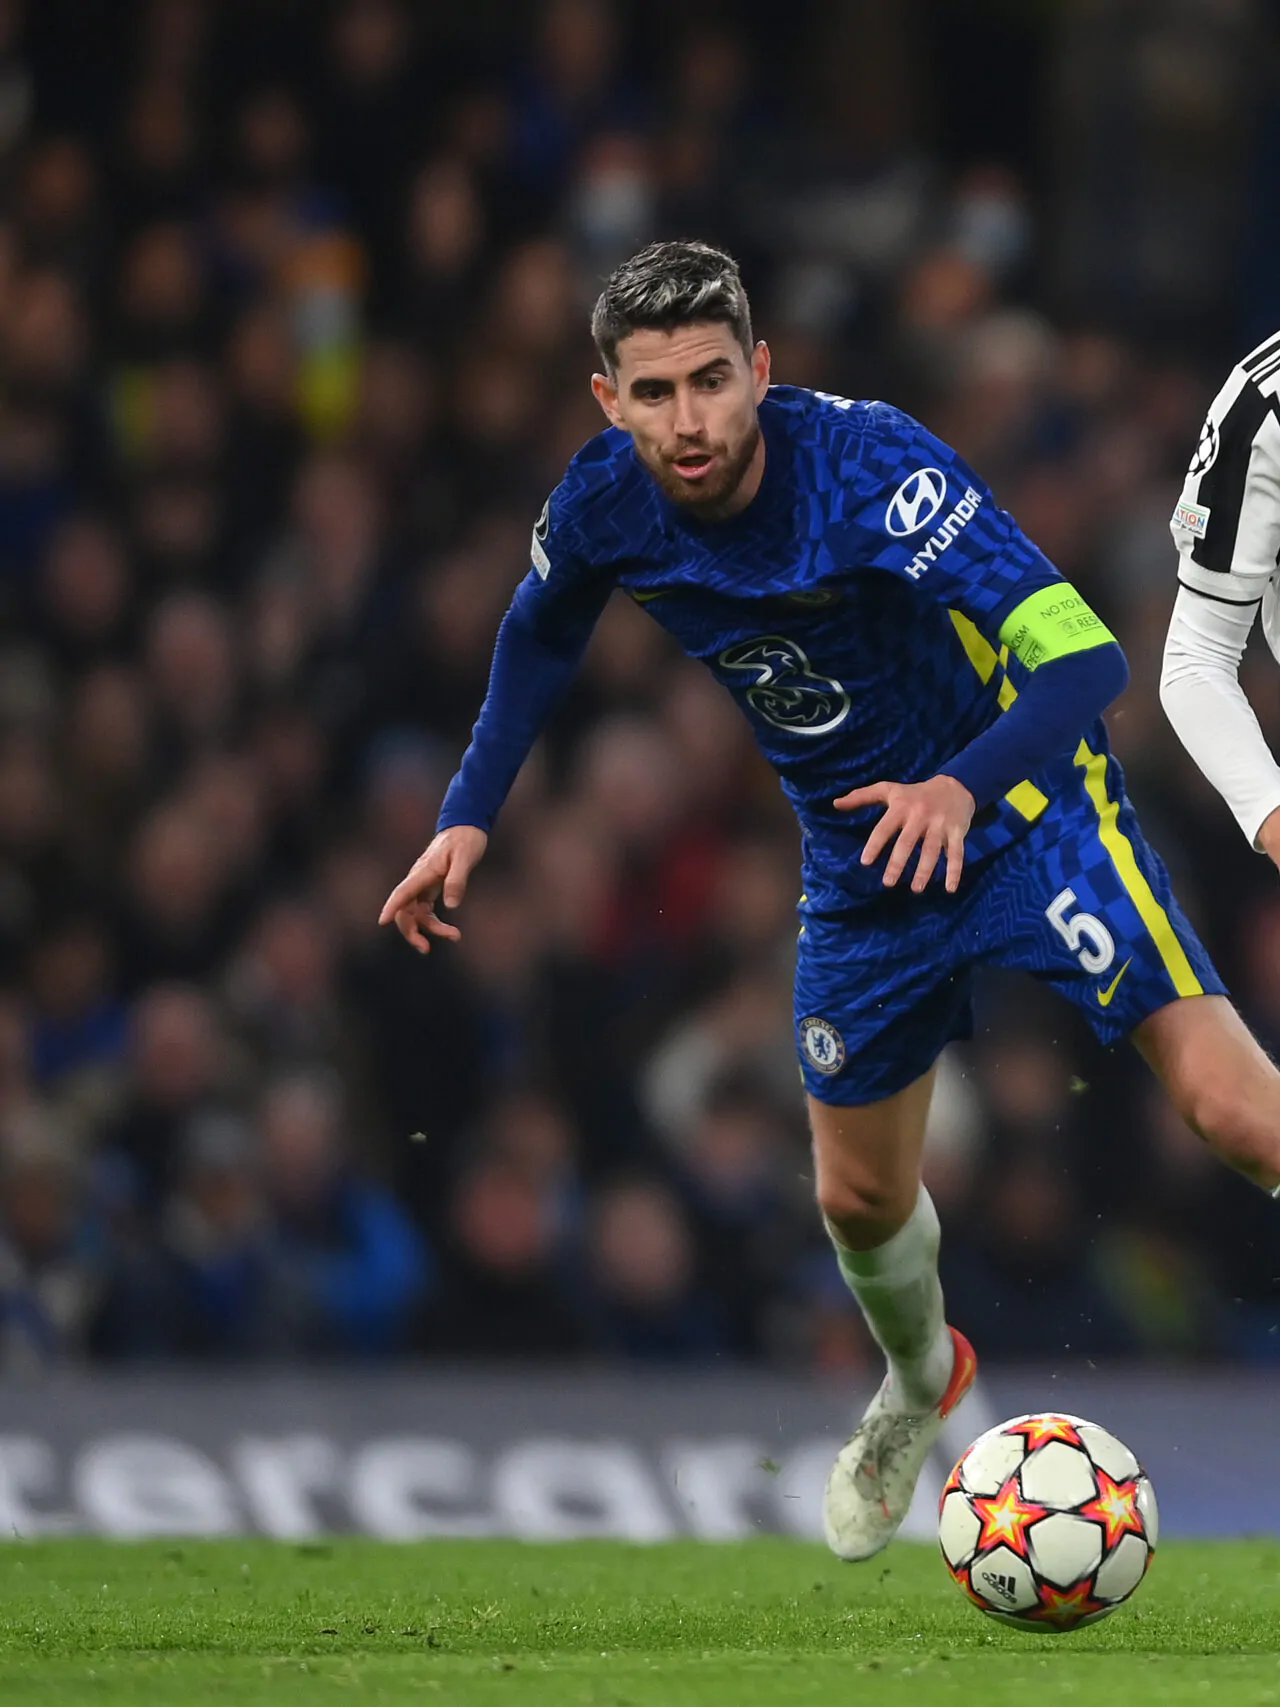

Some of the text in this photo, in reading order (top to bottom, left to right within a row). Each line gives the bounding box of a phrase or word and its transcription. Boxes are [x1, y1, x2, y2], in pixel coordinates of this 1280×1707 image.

[904, 486, 982, 579] HYUNDAI
[1040, 604, 1060, 619] NO
[1060, 598, 1075, 610] TO
[1076, 615, 1099, 628] RES
[1045, 887, 1115, 974] 5
[982, 1572, 1017, 1604] adidas
